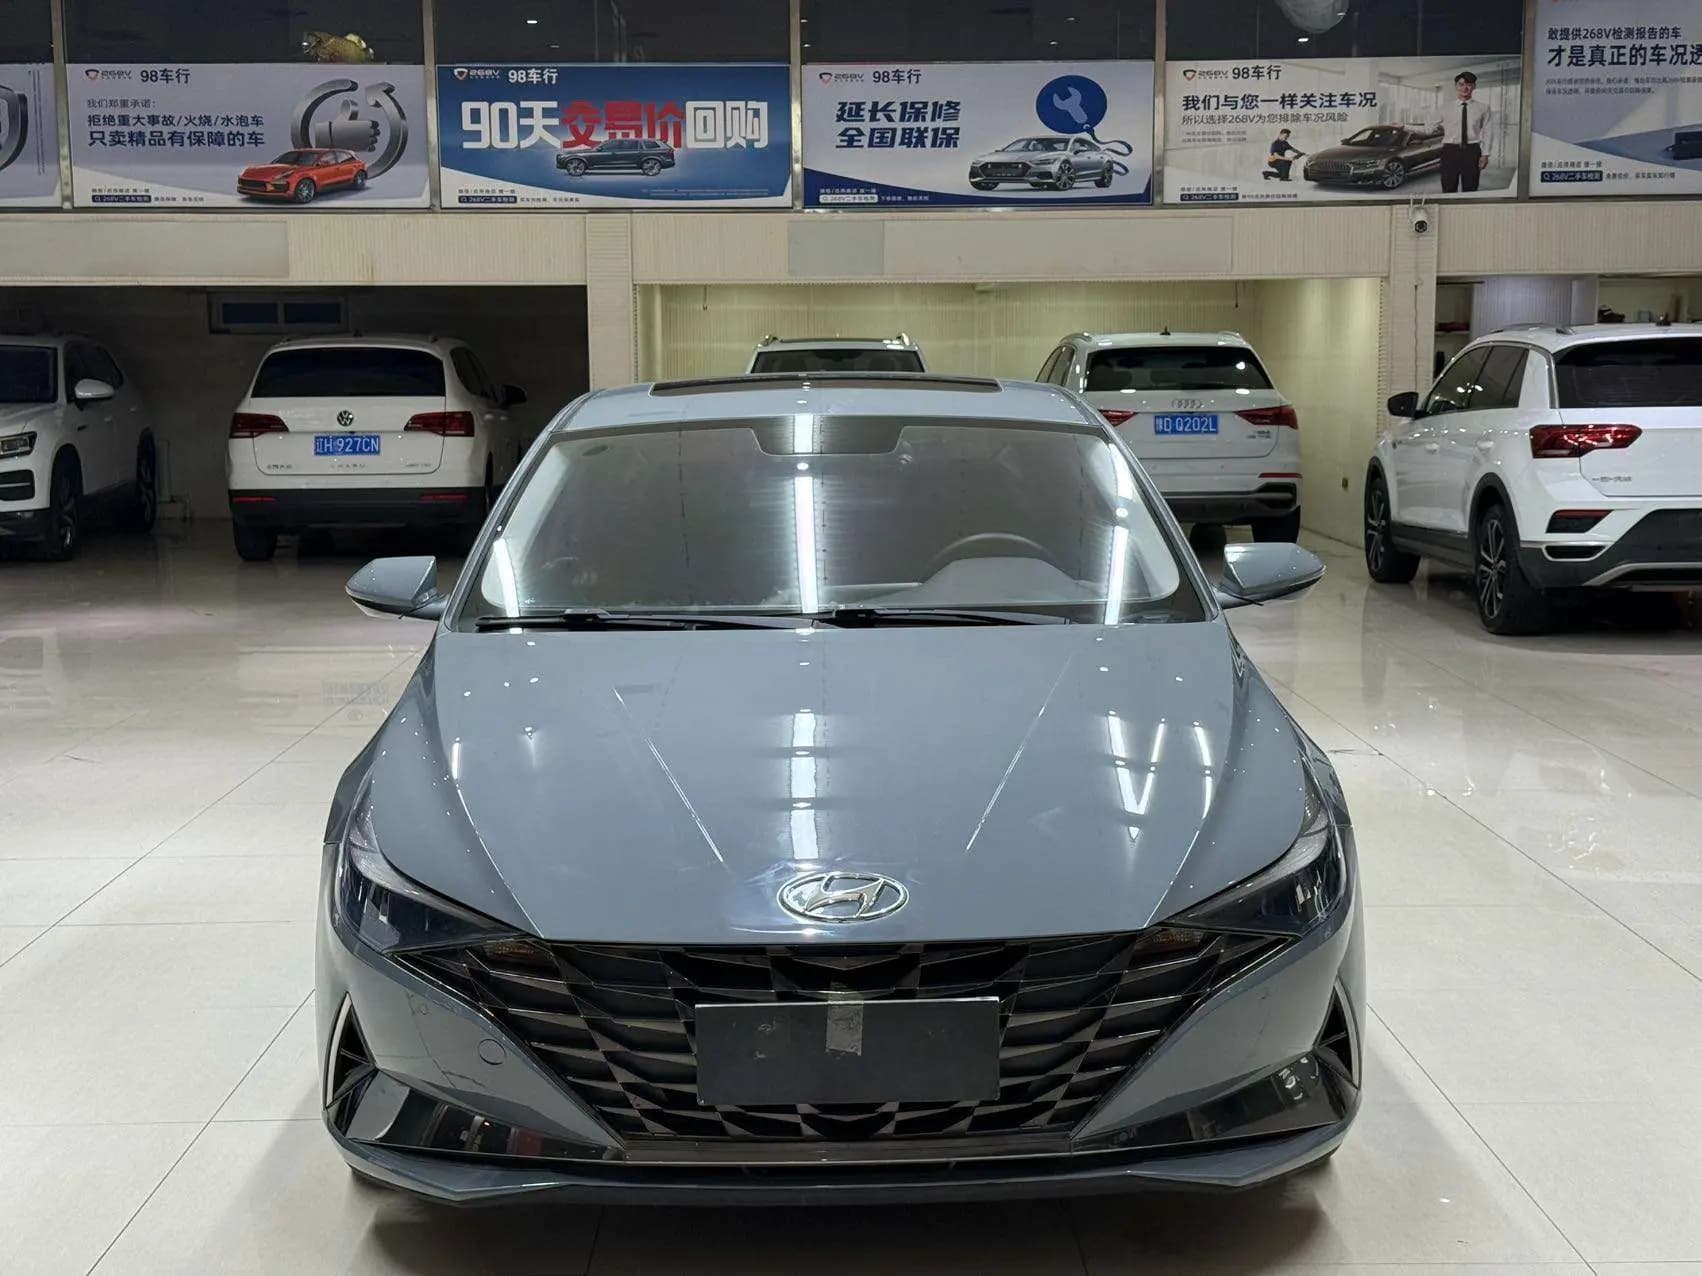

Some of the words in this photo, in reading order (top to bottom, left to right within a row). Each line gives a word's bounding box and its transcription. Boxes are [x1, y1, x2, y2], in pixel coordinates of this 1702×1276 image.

[1547, 26, 1682, 41] 敢提供268V检测报告的车
[140, 67, 190, 84] 98车行
[508, 68, 558, 84] 98车行
[872, 69, 921, 84] 98车行
[1232, 64, 1282, 80] 98车行
[1182, 92, 1378, 111] 我们与您一样关注车况
[835, 101, 961, 123] 延长保修
[1181, 112, 1349, 125] 所以选择268V为您排除车况风险
[87, 114, 264, 127] 拒绝重大事故/火烧/水泡车
[461, 101, 768, 149] 90天交易价回购
[88, 130, 265, 147] 只卖精品有保障的车
[835, 127, 961, 148] 全国联保
